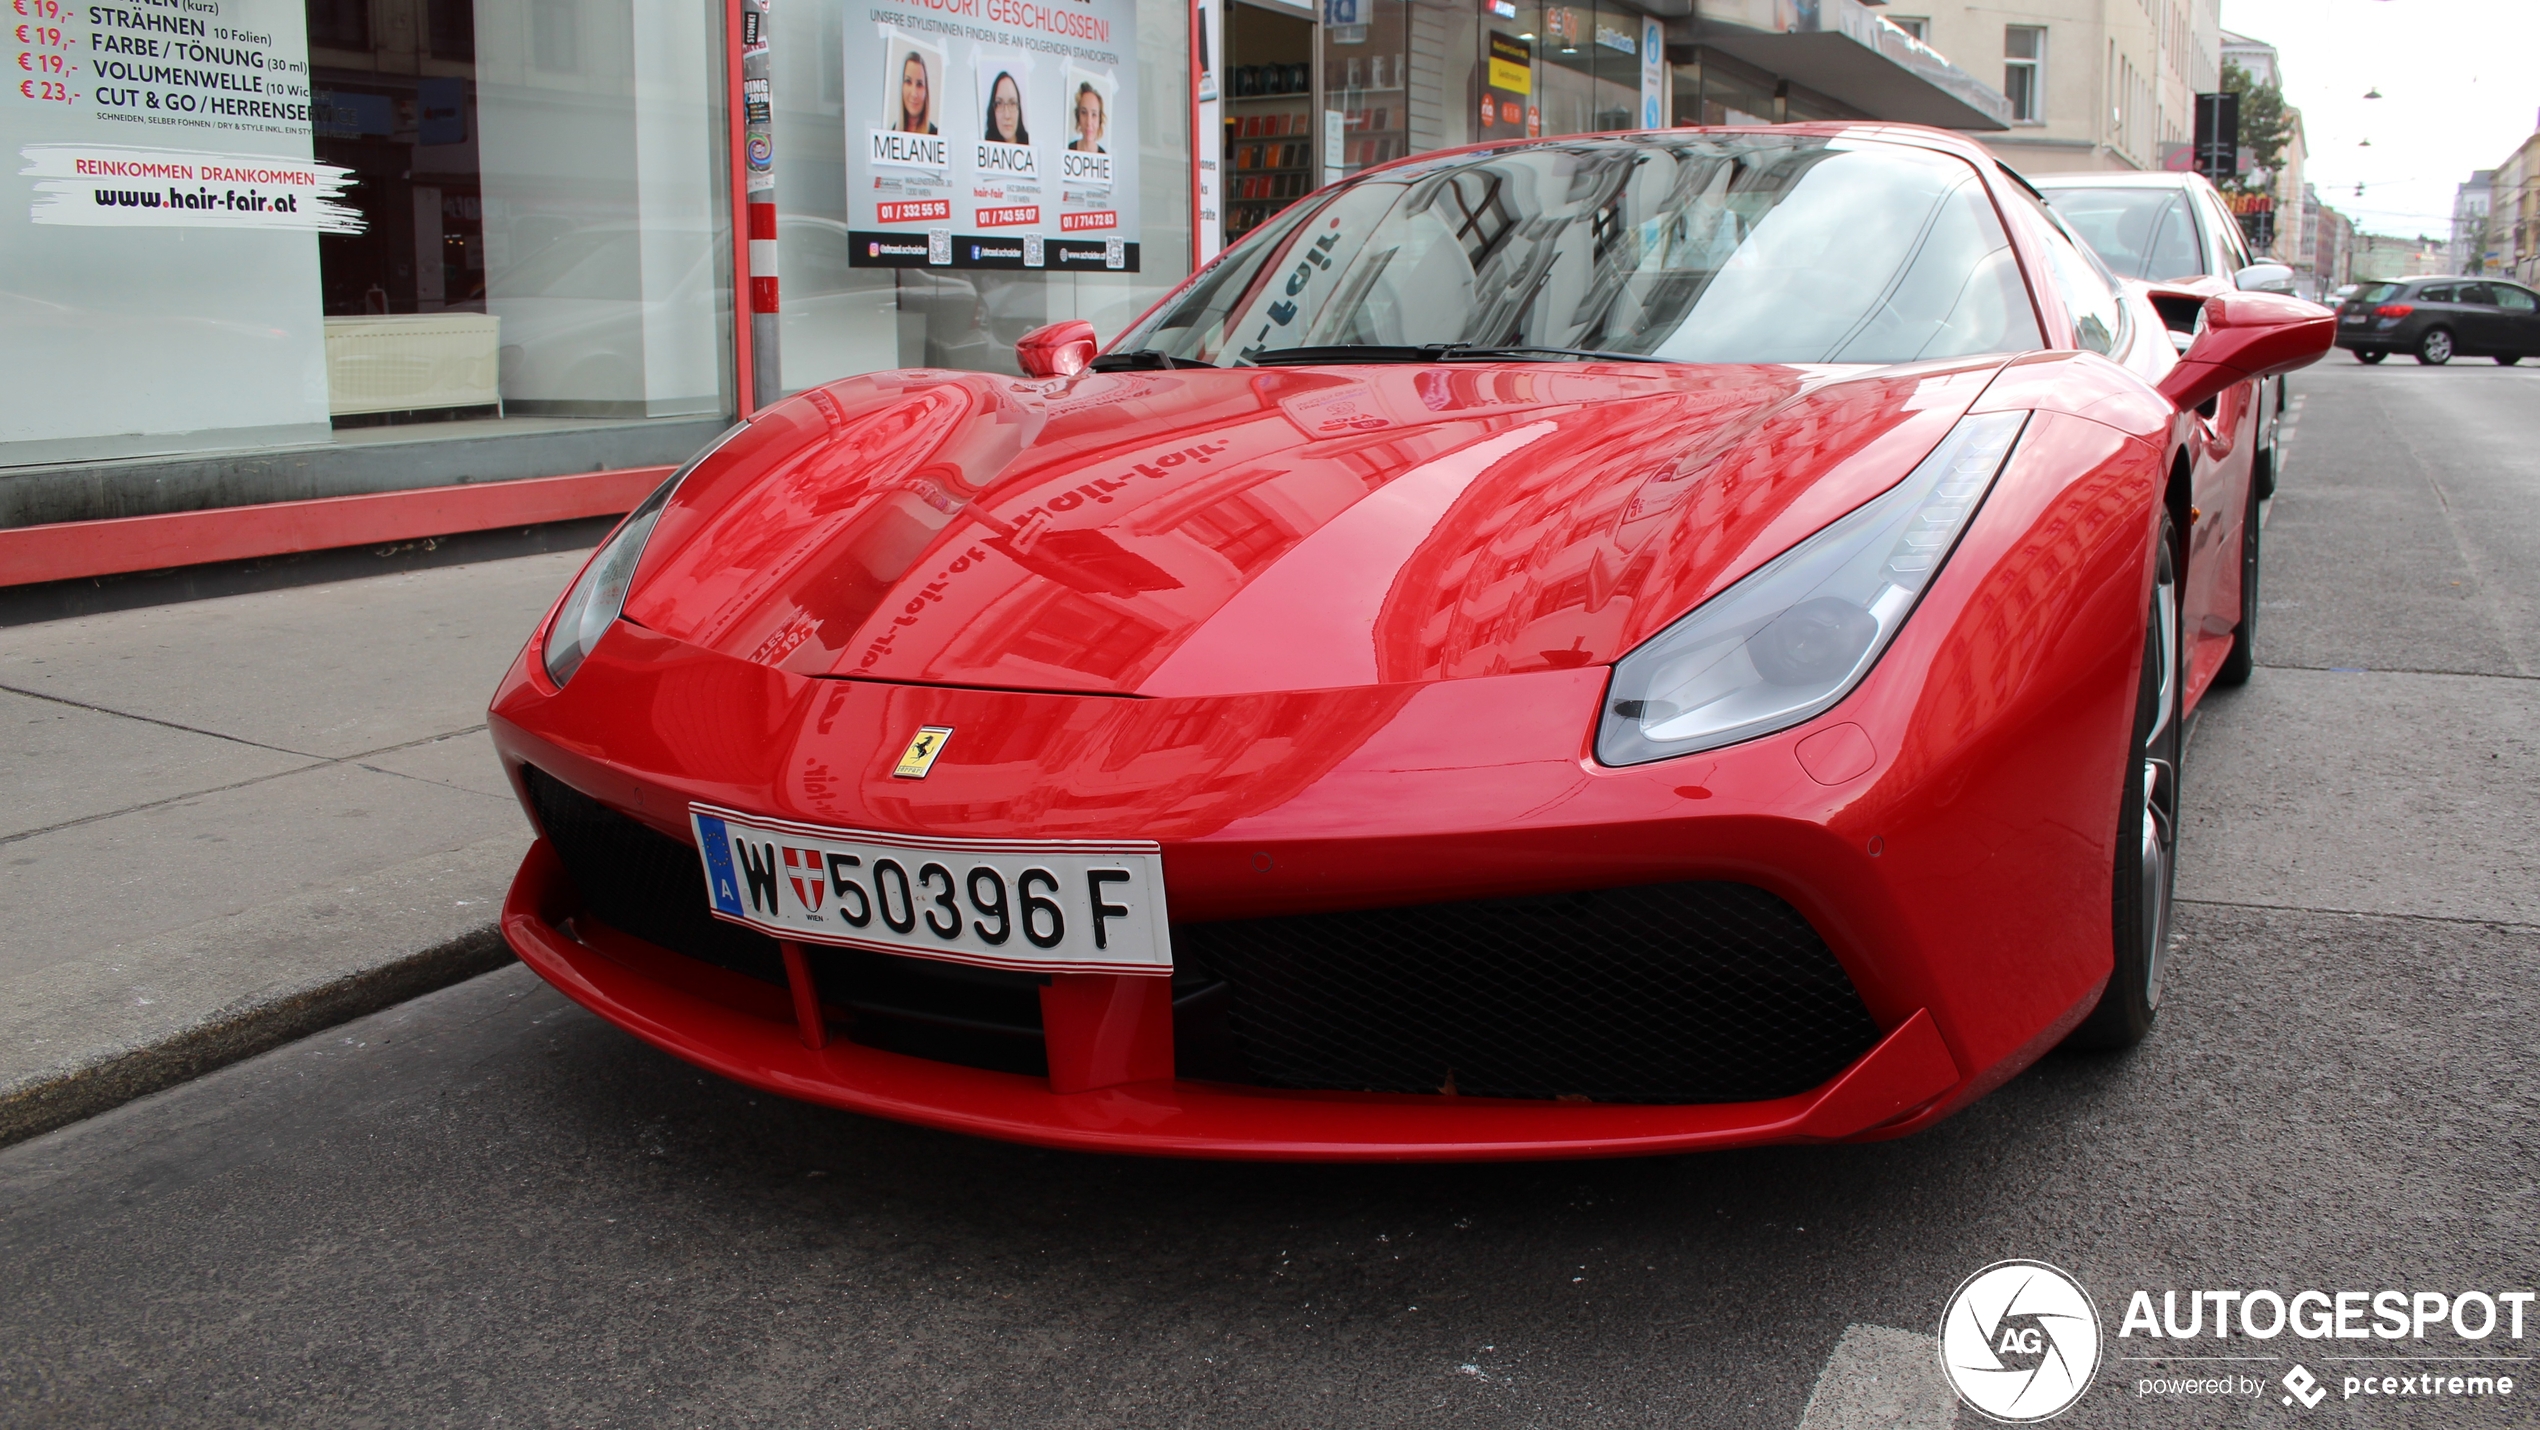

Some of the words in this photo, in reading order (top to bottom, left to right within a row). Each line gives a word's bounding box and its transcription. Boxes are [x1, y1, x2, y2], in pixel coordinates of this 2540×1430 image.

[34, 0, 74, 24] 19,-
[89, 6, 205, 37] STRÄHNEN
[214, 28, 228, 39] 10
[231, 29, 272, 48] Folien)
[986, 0, 1110, 43] GESCHLOSSEN!
[870, 9, 905, 27] UNSERE
[907, 16, 963, 37] STYLISTINNEN
[966, 26, 996, 43] FINDEN
[998, 32, 1010, 46] SIE
[1011, 35, 1023, 48] AN
[1025, 37, 1072, 57] FOLGENDEN
[1073, 46, 1119, 65] STANDORTEN
[16, 25, 30, 43] €
[36, 27, 76, 51] 19,-
[91, 33, 159, 57] FARBE
[175, 40, 264, 68] TÖNUNG
[268, 59, 286, 73] (30
[289, 61, 308, 76] ml)
[18, 53, 33, 71] €
[38, 55, 78, 78] 19,-
[93, 60, 262, 93] VOLUMENWELLE
[266, 82, 284, 97] (10
[20, 80, 35, 99] €
[40, 81, 81, 105] 23,-
[96, 87, 140, 107] CUT
[146, 91, 160, 109] &
[165, 93, 196, 112] GO
[749, 93, 769, 104] 2018
[96, 112, 147, 124] SCHNEIDEN,
[148, 116, 176, 126] SELBER
[217, 121, 233, 130] DRY
[242, 124, 264, 132] STYLE
[874, 135, 945, 164] MELANIE
[977, 146, 1034, 172] BIANCA
[76, 159, 193, 180] REINKOMMEN
[201, 166, 315, 186] DRANKOMMEN
[1064, 155, 1110, 179] SOPHIE
[1200, 160, 1216, 171] ones
[95, 187, 297, 213] www.hair-fair.at
[974, 187, 1003, 200] hair-fair
[881, 205, 893, 219] 01
[903, 204, 920, 218] 332
[921, 203, 933, 217] 55
[934, 202, 946, 216] 95
[979, 211, 989, 223] 01
[998, 210, 1014, 222] 743
[1014, 209, 1026, 221] 55
[1026, 208, 1036, 220] 07
[1063, 217, 1072, 228] 01
[1080, 215, 1093, 227] 714
[720, 879, 734, 900] A
[735, 836, 779, 917] W
[825, 853, 1065, 949] 50396
[1086, 868, 1131, 951] F
[806, 914, 824, 922] WIEN
